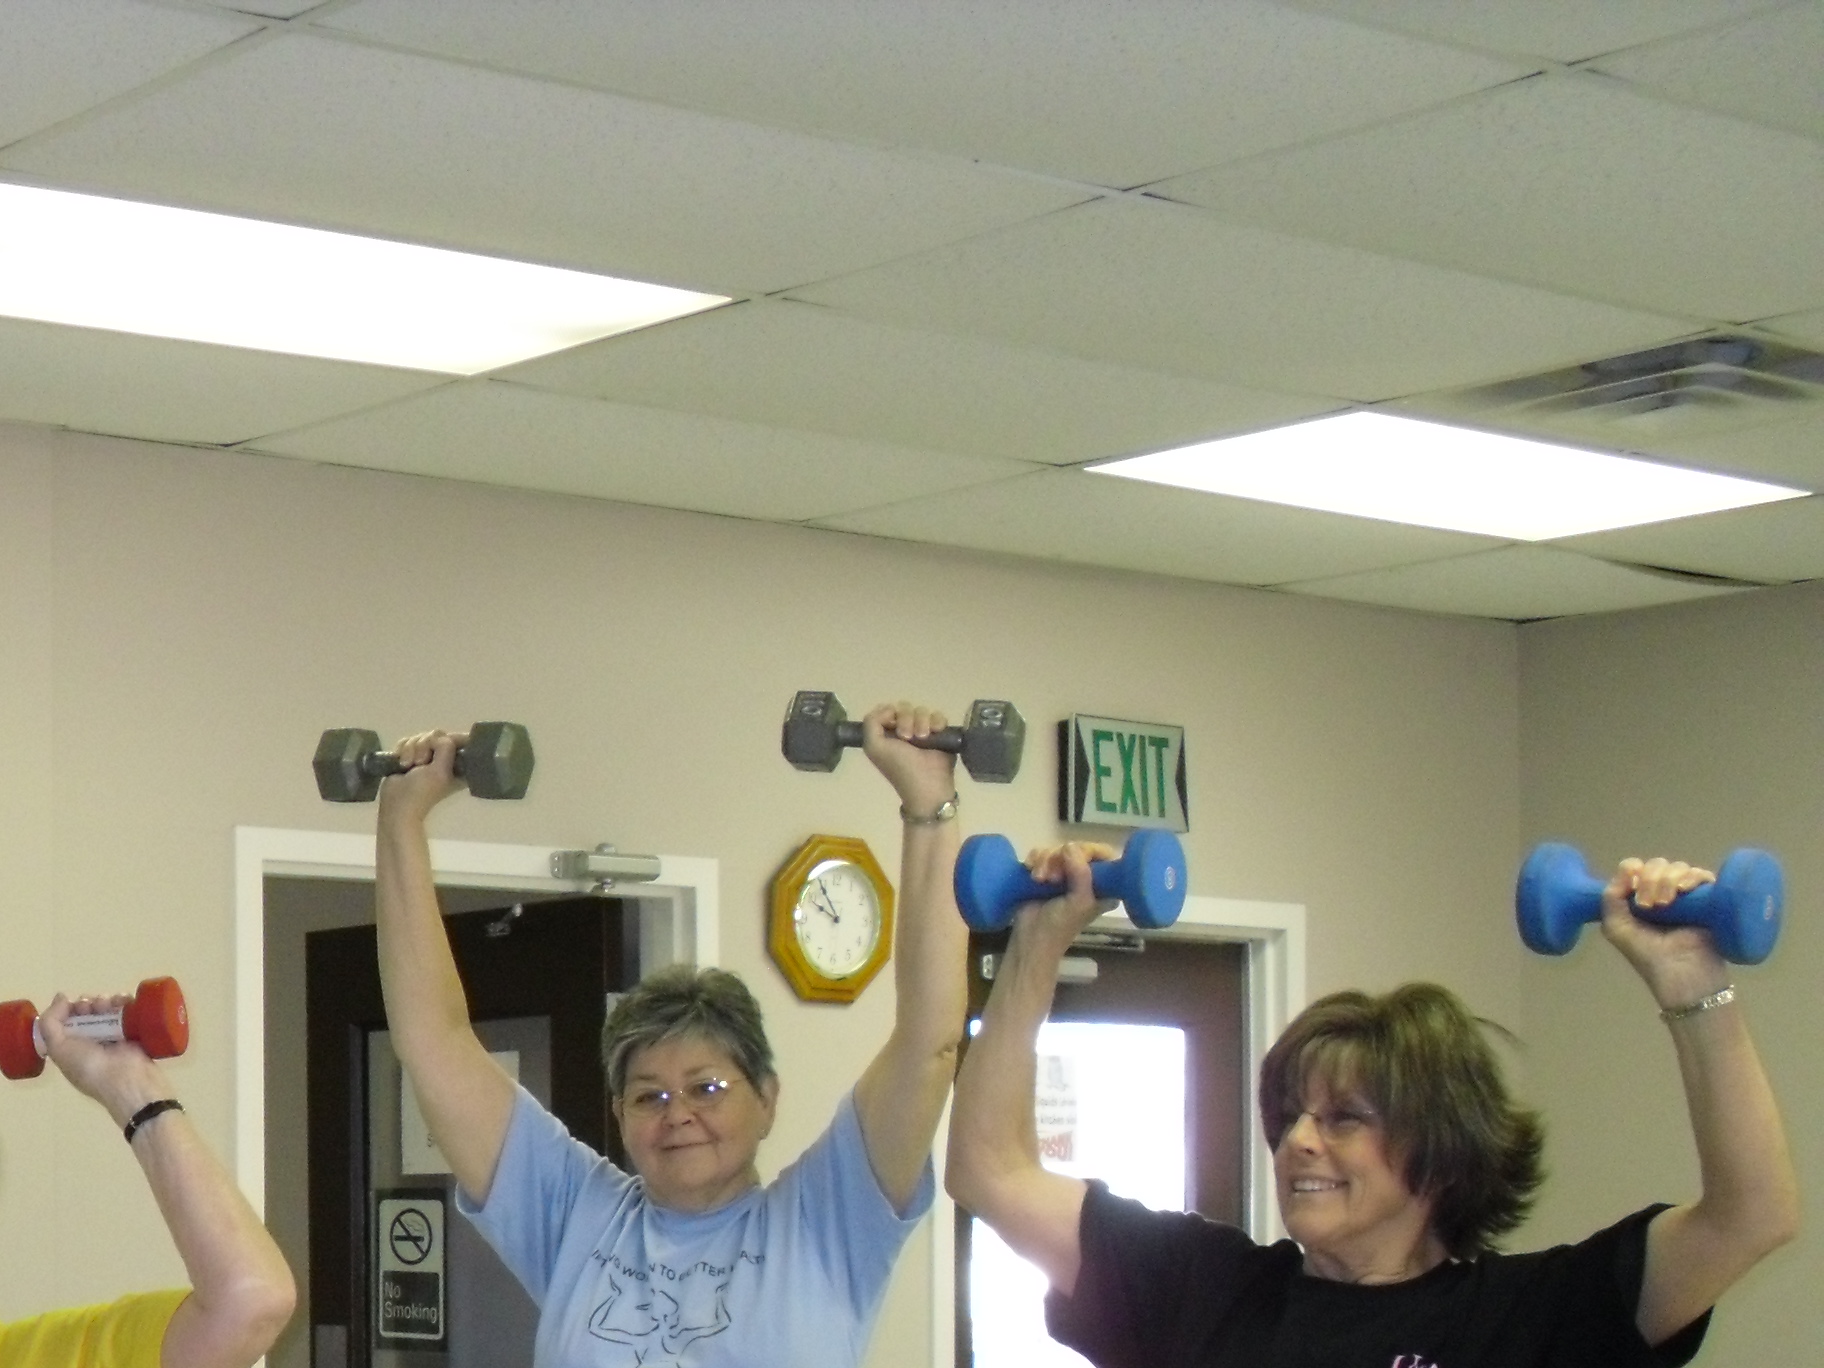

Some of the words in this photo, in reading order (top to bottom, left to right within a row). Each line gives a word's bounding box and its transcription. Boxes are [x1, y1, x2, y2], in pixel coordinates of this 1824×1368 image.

[1092, 729, 1169, 818] EXIT
[659, 1263, 676, 1281] TO
[384, 1281, 402, 1299] No
[384, 1301, 438, 1324] Smoking
